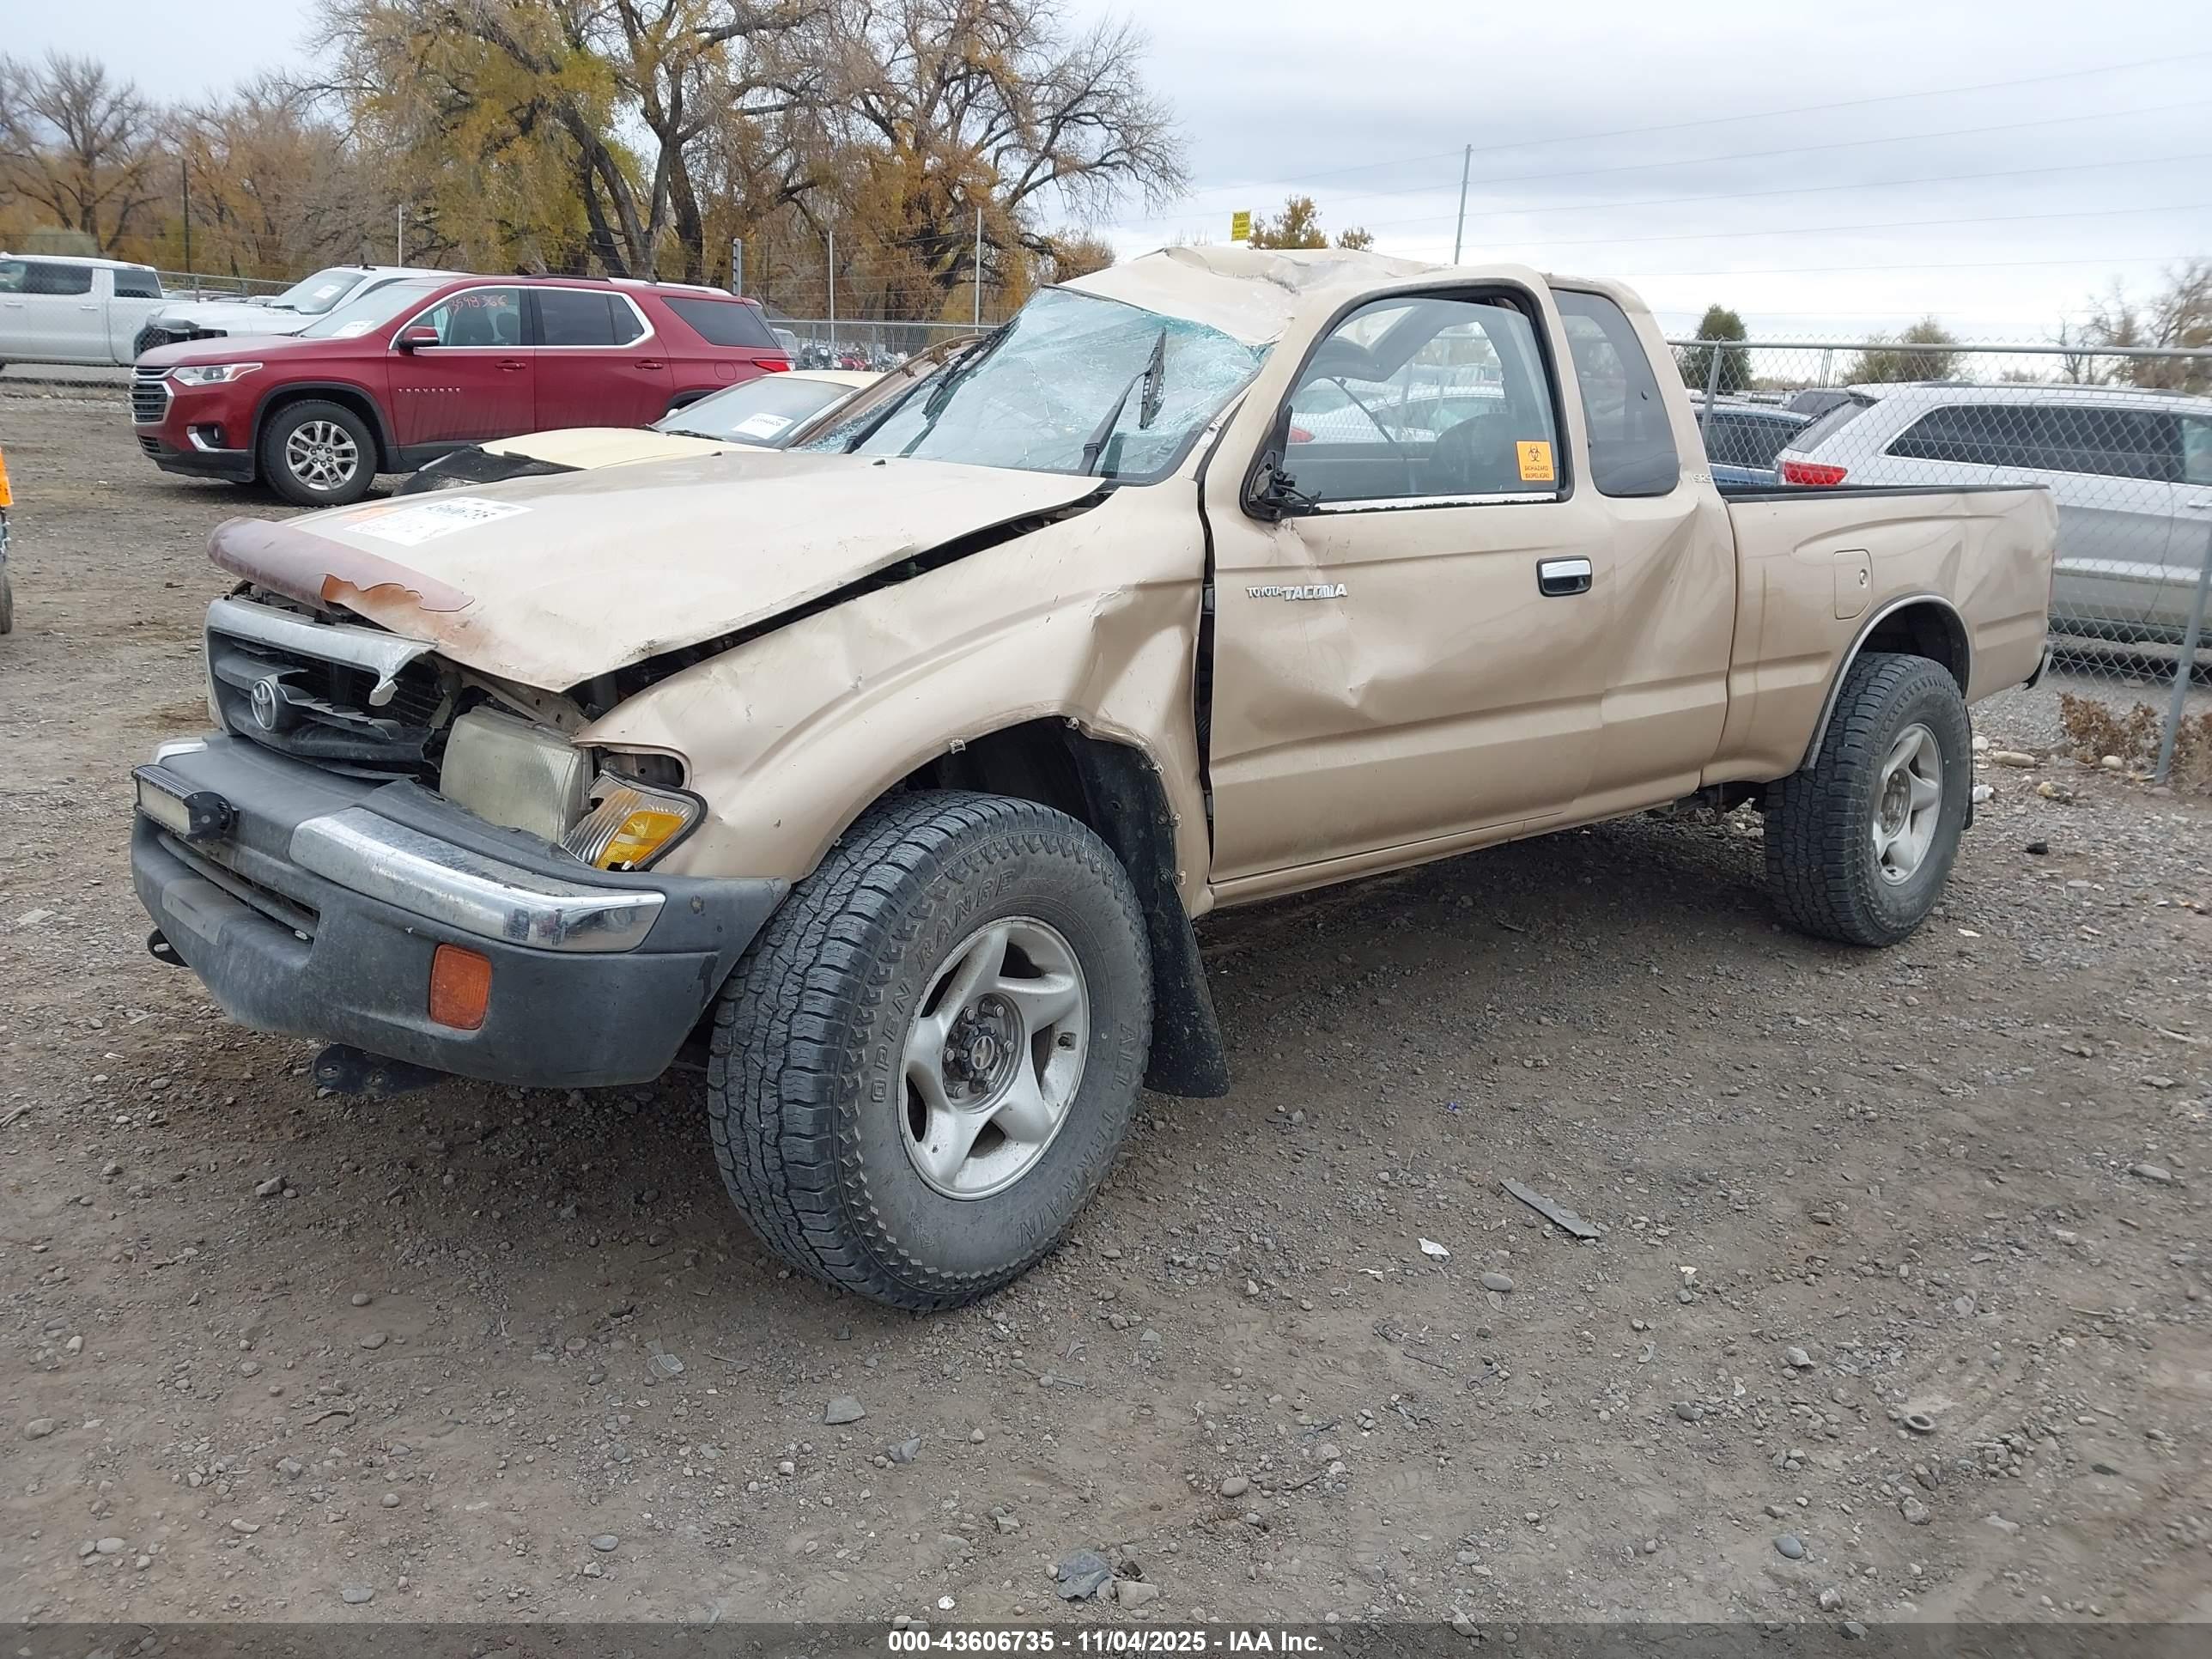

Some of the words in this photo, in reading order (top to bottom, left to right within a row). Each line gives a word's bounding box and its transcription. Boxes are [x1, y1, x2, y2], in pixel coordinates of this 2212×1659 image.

[1246, 586, 1282, 599] TOYOTA
[1280, 583, 1348, 601] TACOMA
[871, 980, 912, 1103] OPEN
[915, 868, 1016, 971] RANGE
[1112, 1023, 1137, 1091] ALL
[1019, 1109, 1115, 1247] TERRAIN
